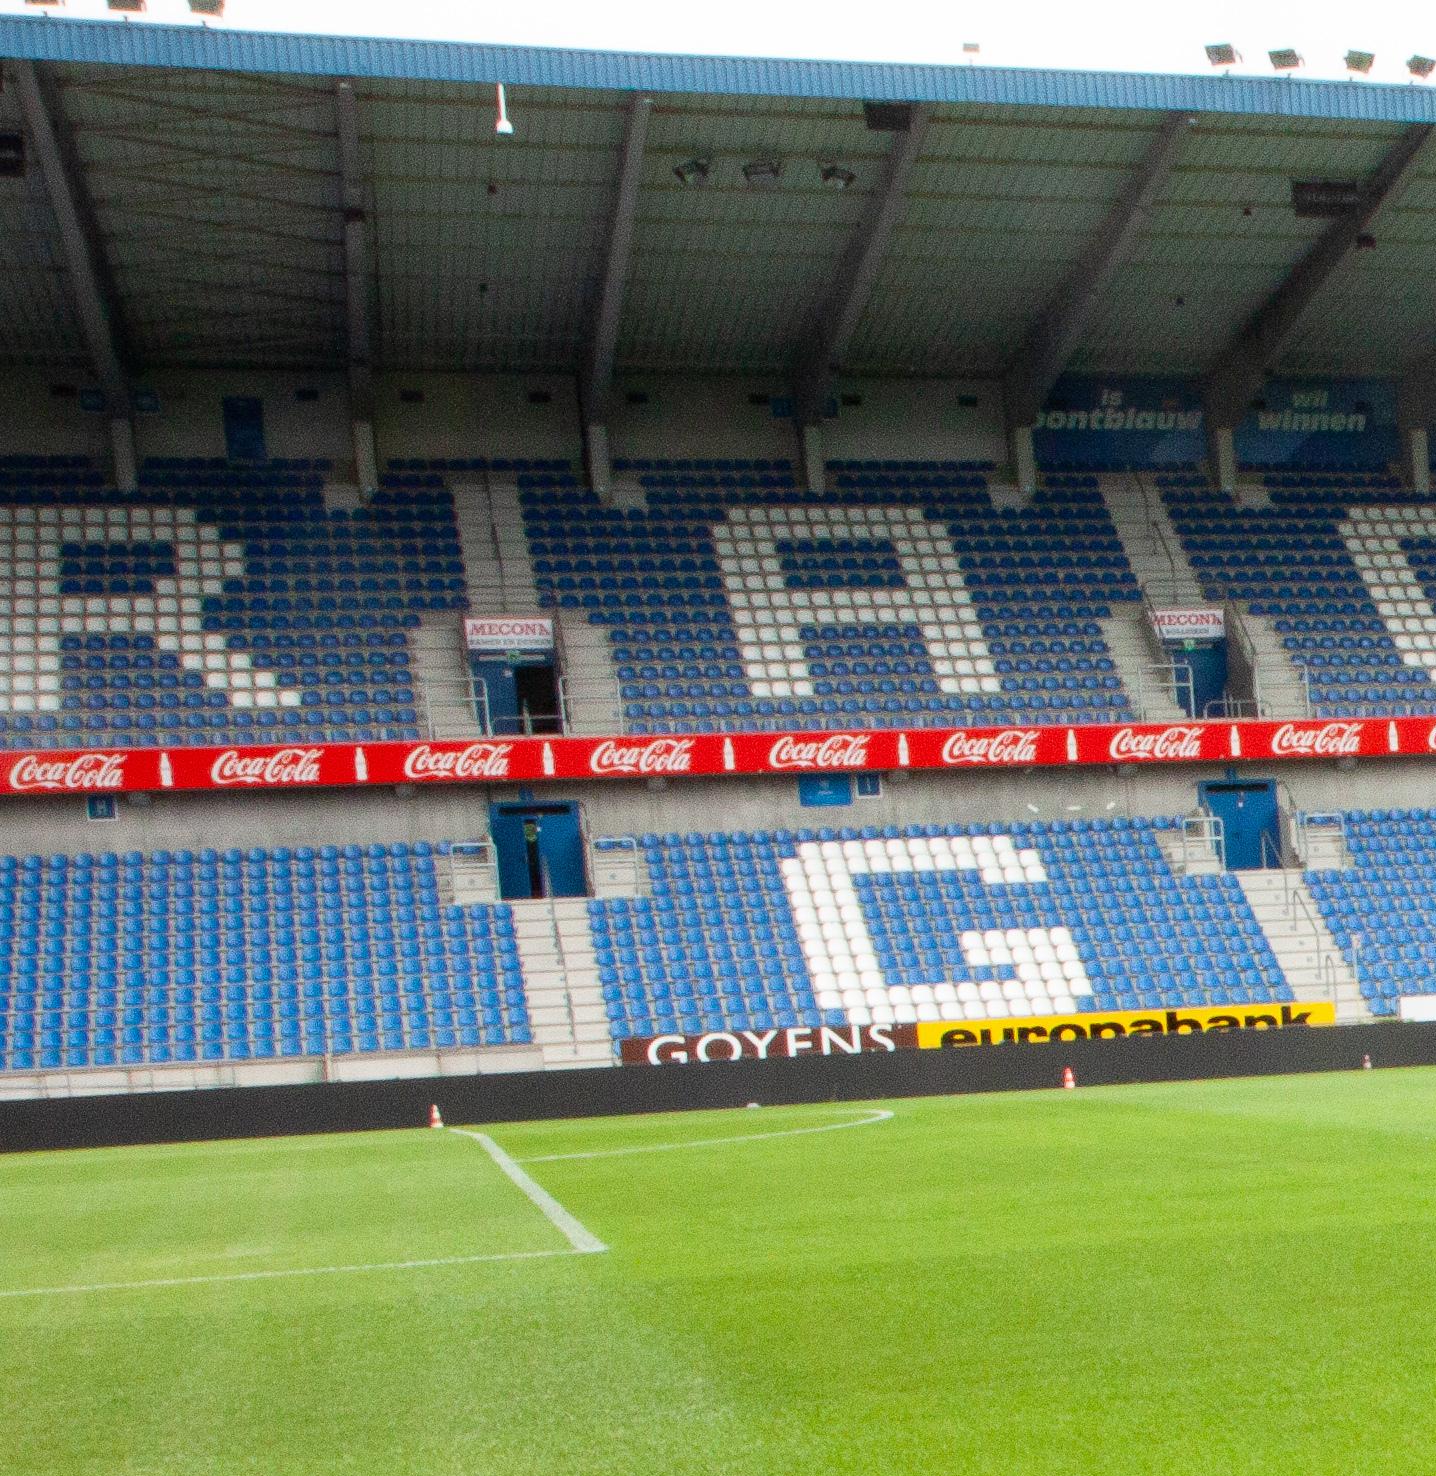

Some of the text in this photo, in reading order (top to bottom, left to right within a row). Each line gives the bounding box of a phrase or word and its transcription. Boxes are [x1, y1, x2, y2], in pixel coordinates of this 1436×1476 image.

[1258, 409, 1367, 432] winnen
[471, 622, 551, 636] MECONA
[1152, 613, 1222, 626] MECONA
[590, 738, 696, 774] Coca-Cola
[768, 734, 872, 770] Coca-Cola
[942, 730, 1041, 765] Coca-Cola
[1109, 726, 1204, 760] Coca-Cola
[1270, 723, 1365, 756] Coca-Cola
[9, 754, 128, 791] Coca-Cola
[211, 749, 324, 785] Coca-Cola
[404, 744, 514, 780] Coca-Cola
[646, 1023, 896, 1066] GOYENS
[939, 1005, 1313, 1048] europabank
